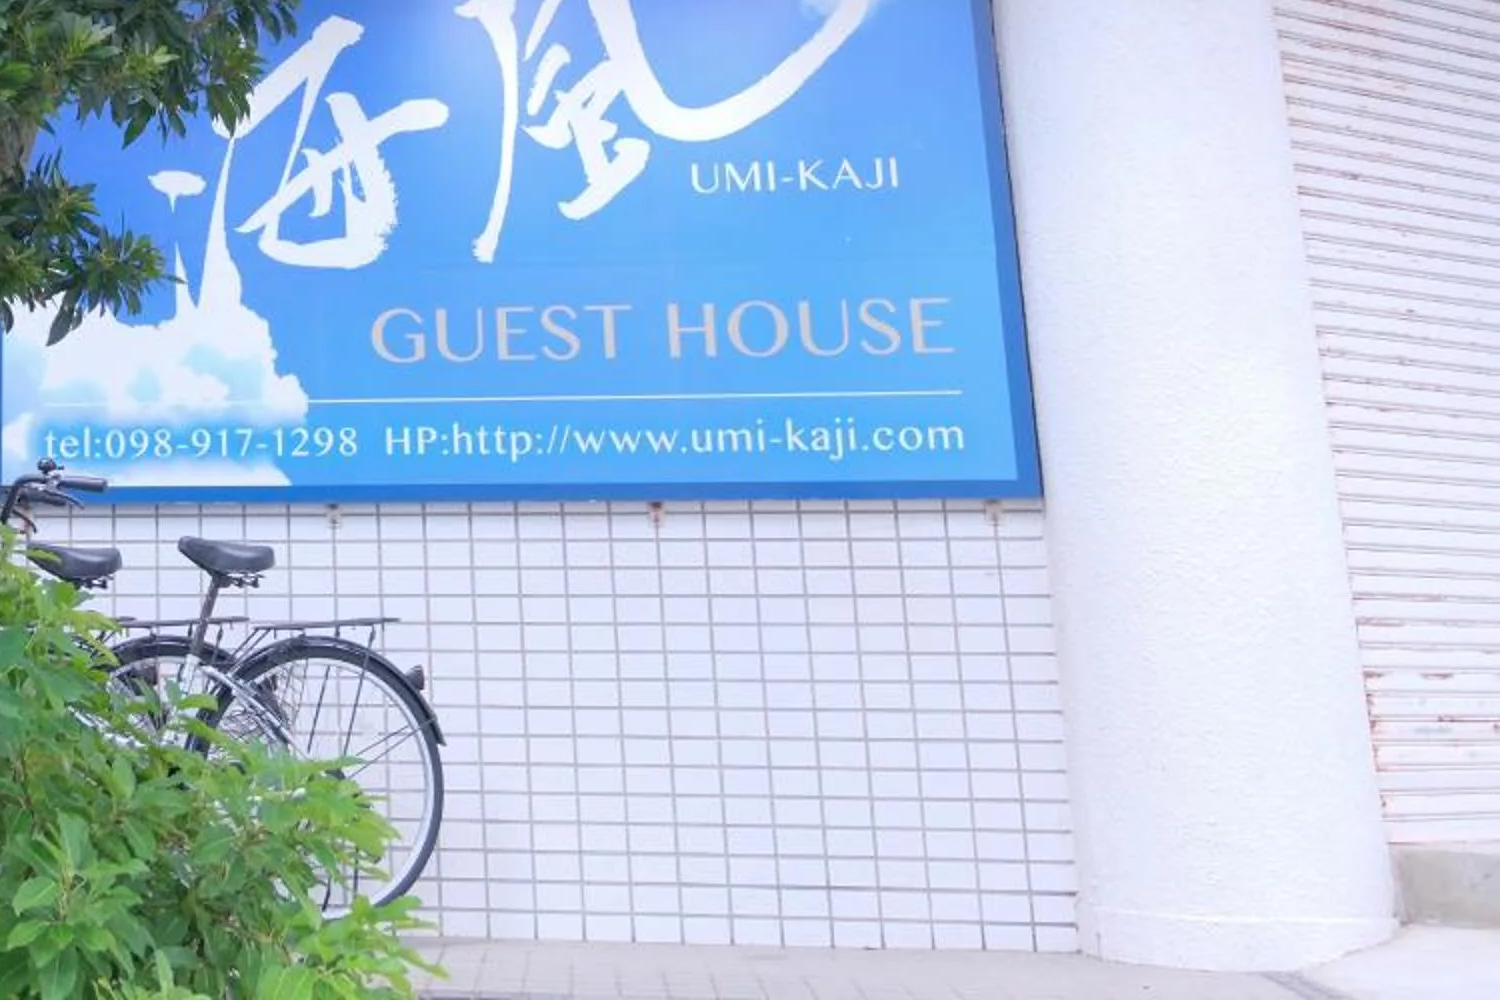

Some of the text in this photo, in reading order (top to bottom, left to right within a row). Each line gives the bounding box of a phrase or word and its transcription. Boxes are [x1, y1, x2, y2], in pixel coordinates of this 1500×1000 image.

[690, 156, 900, 195] UMI-KAJI
[371, 296, 957, 364] GUEST HOUSE
[45, 417, 965, 462] tel:098-917-1298 HP:http://www.umi-kaji.com
